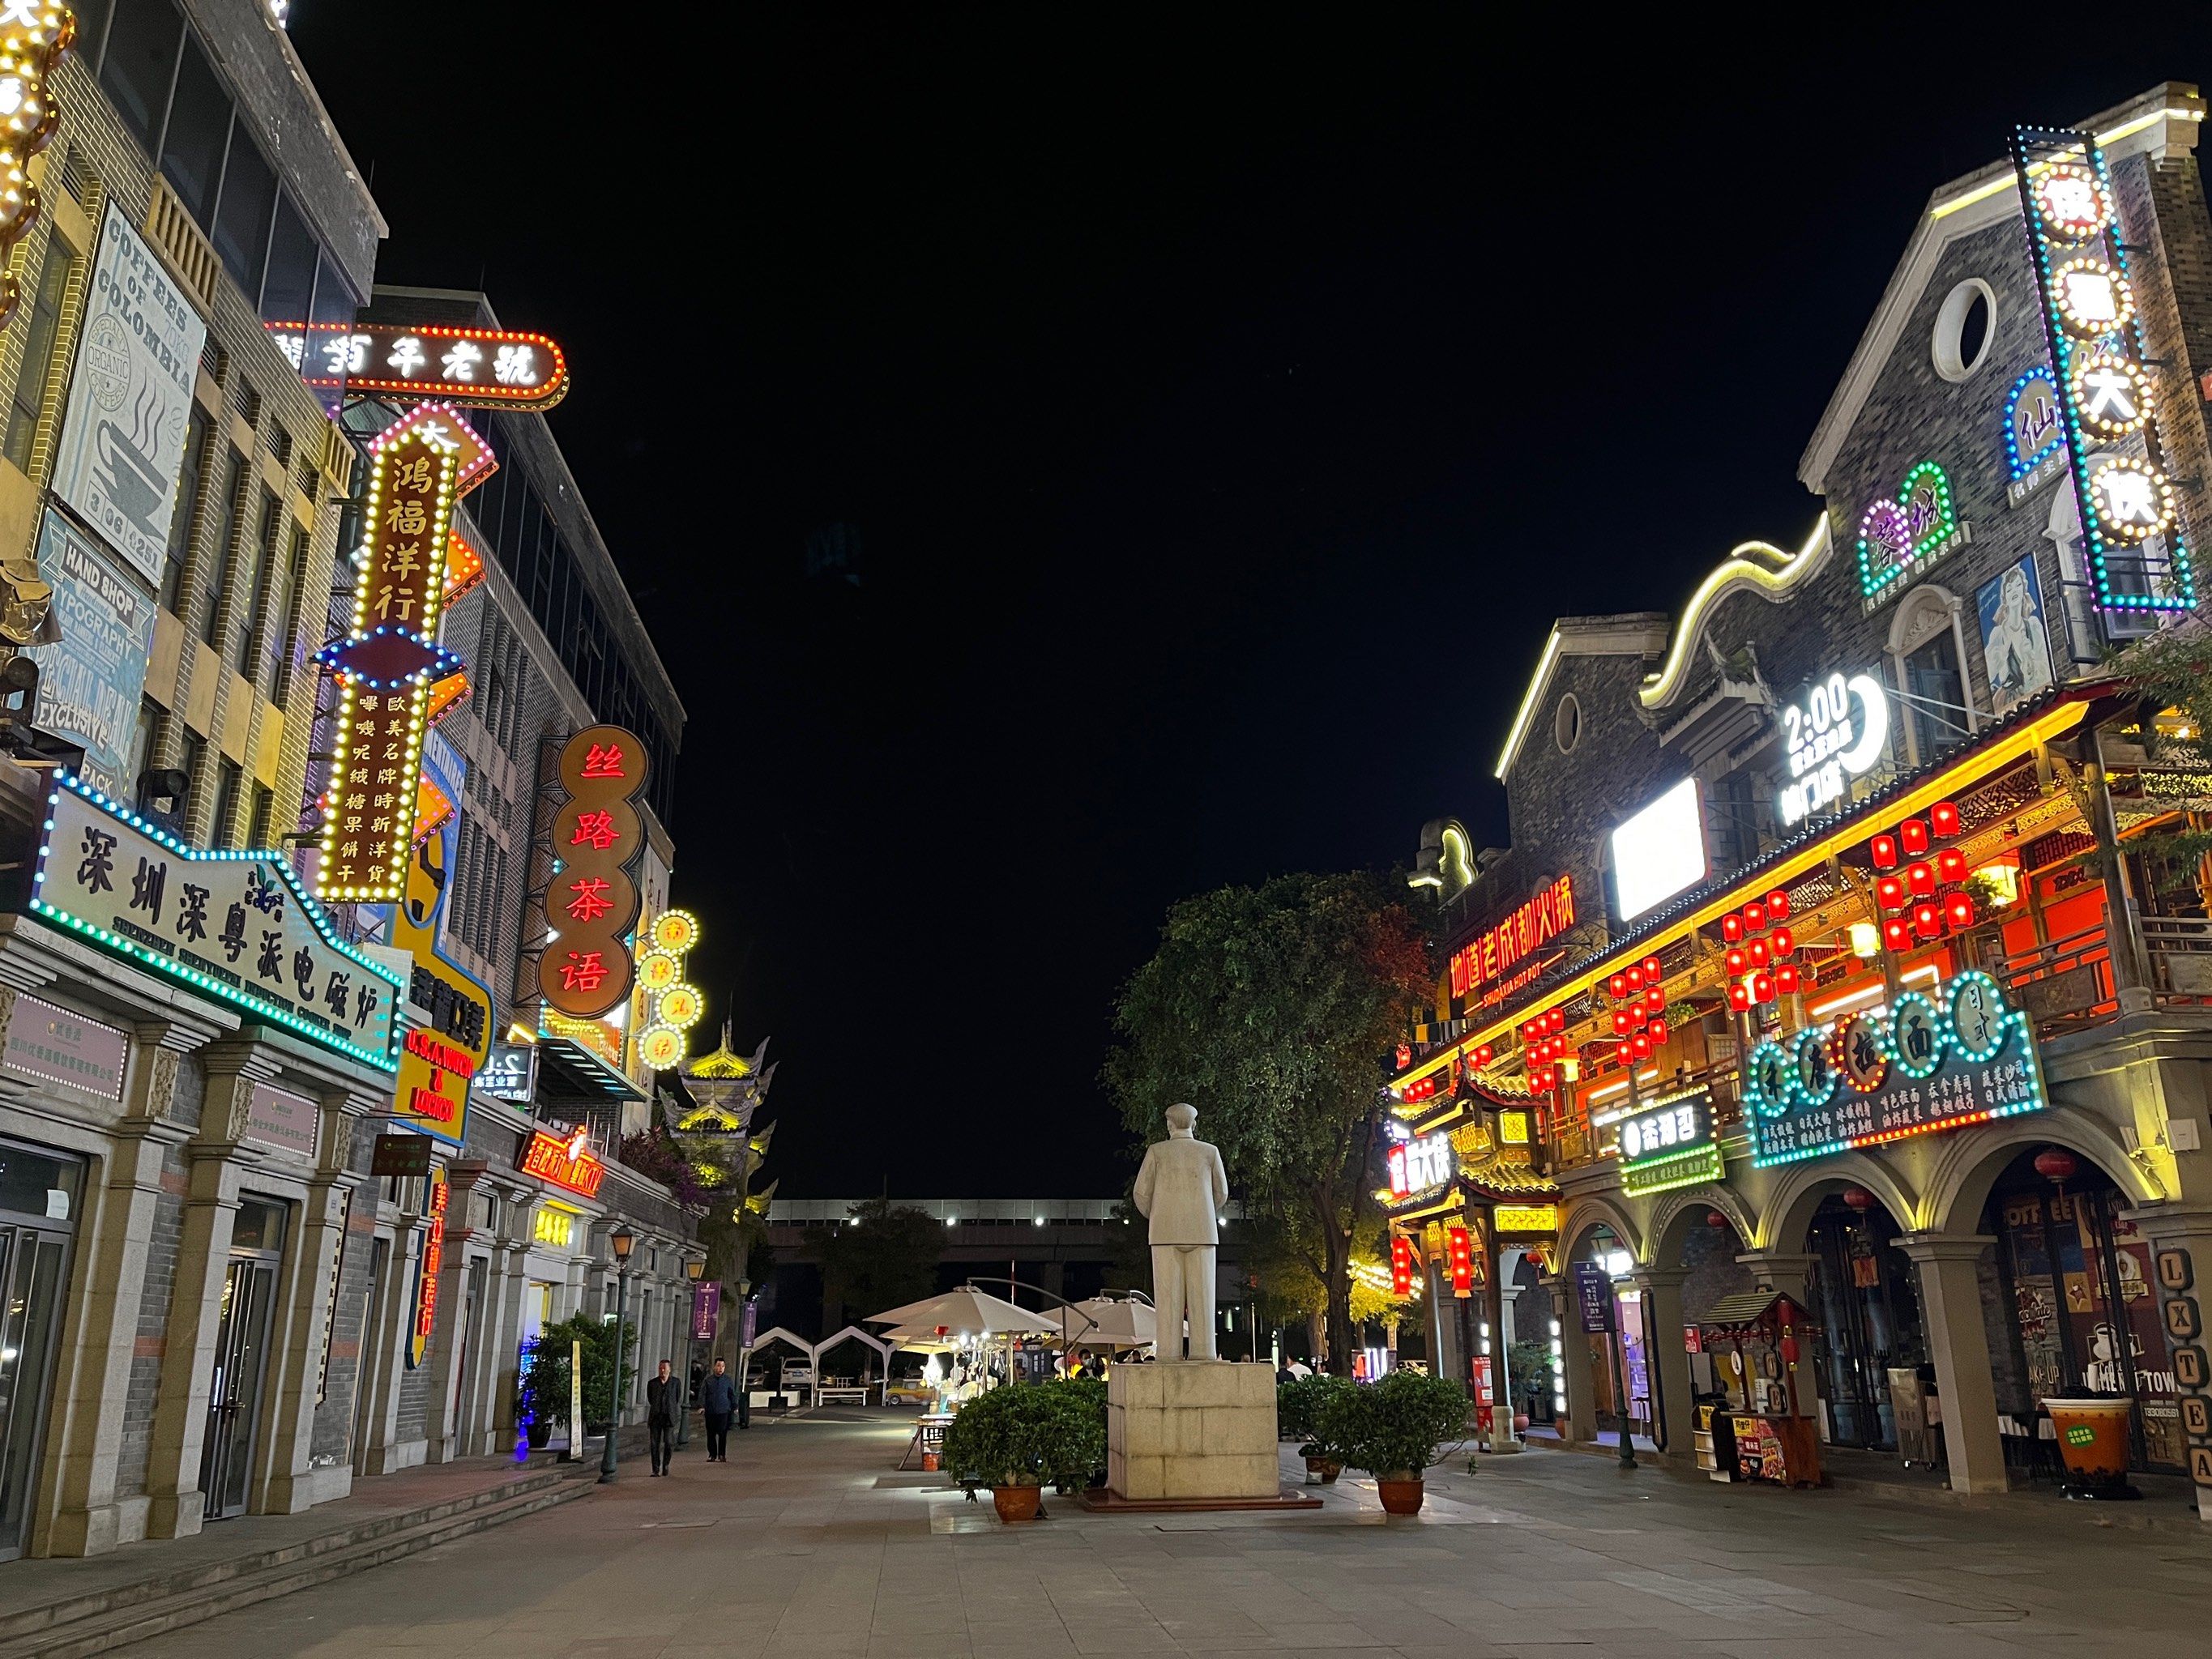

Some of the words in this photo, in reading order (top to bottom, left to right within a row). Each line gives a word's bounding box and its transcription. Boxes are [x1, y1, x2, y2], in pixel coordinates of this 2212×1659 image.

[109, 218, 187, 332] COFFEES
[127, 275, 147, 306] OF
[88, 345, 129, 379] ORGANIC
[98, 268, 190, 399] COLOMBIA
[90, 493, 100, 513] 3
[105, 508, 123, 535] 06
[66, 544, 100, 588] HAND
[101, 576, 134, 616] SHOP
[37, 702, 111, 750] EXCLUSIVE
[1784, 672, 1848, 754] 2:00
[79, 763, 113, 797] PACK
[559, 743, 626, 993] 丝路茶语
[77, 826, 378, 1029] 深圳深粤派电磁炉
[1484, 979, 1514, 1008] SHUDAXIA
[1514, 970, 1527, 990] HOT
[1527, 962, 1541, 982] POT
[1968, 984, 1990, 1043] 日式
